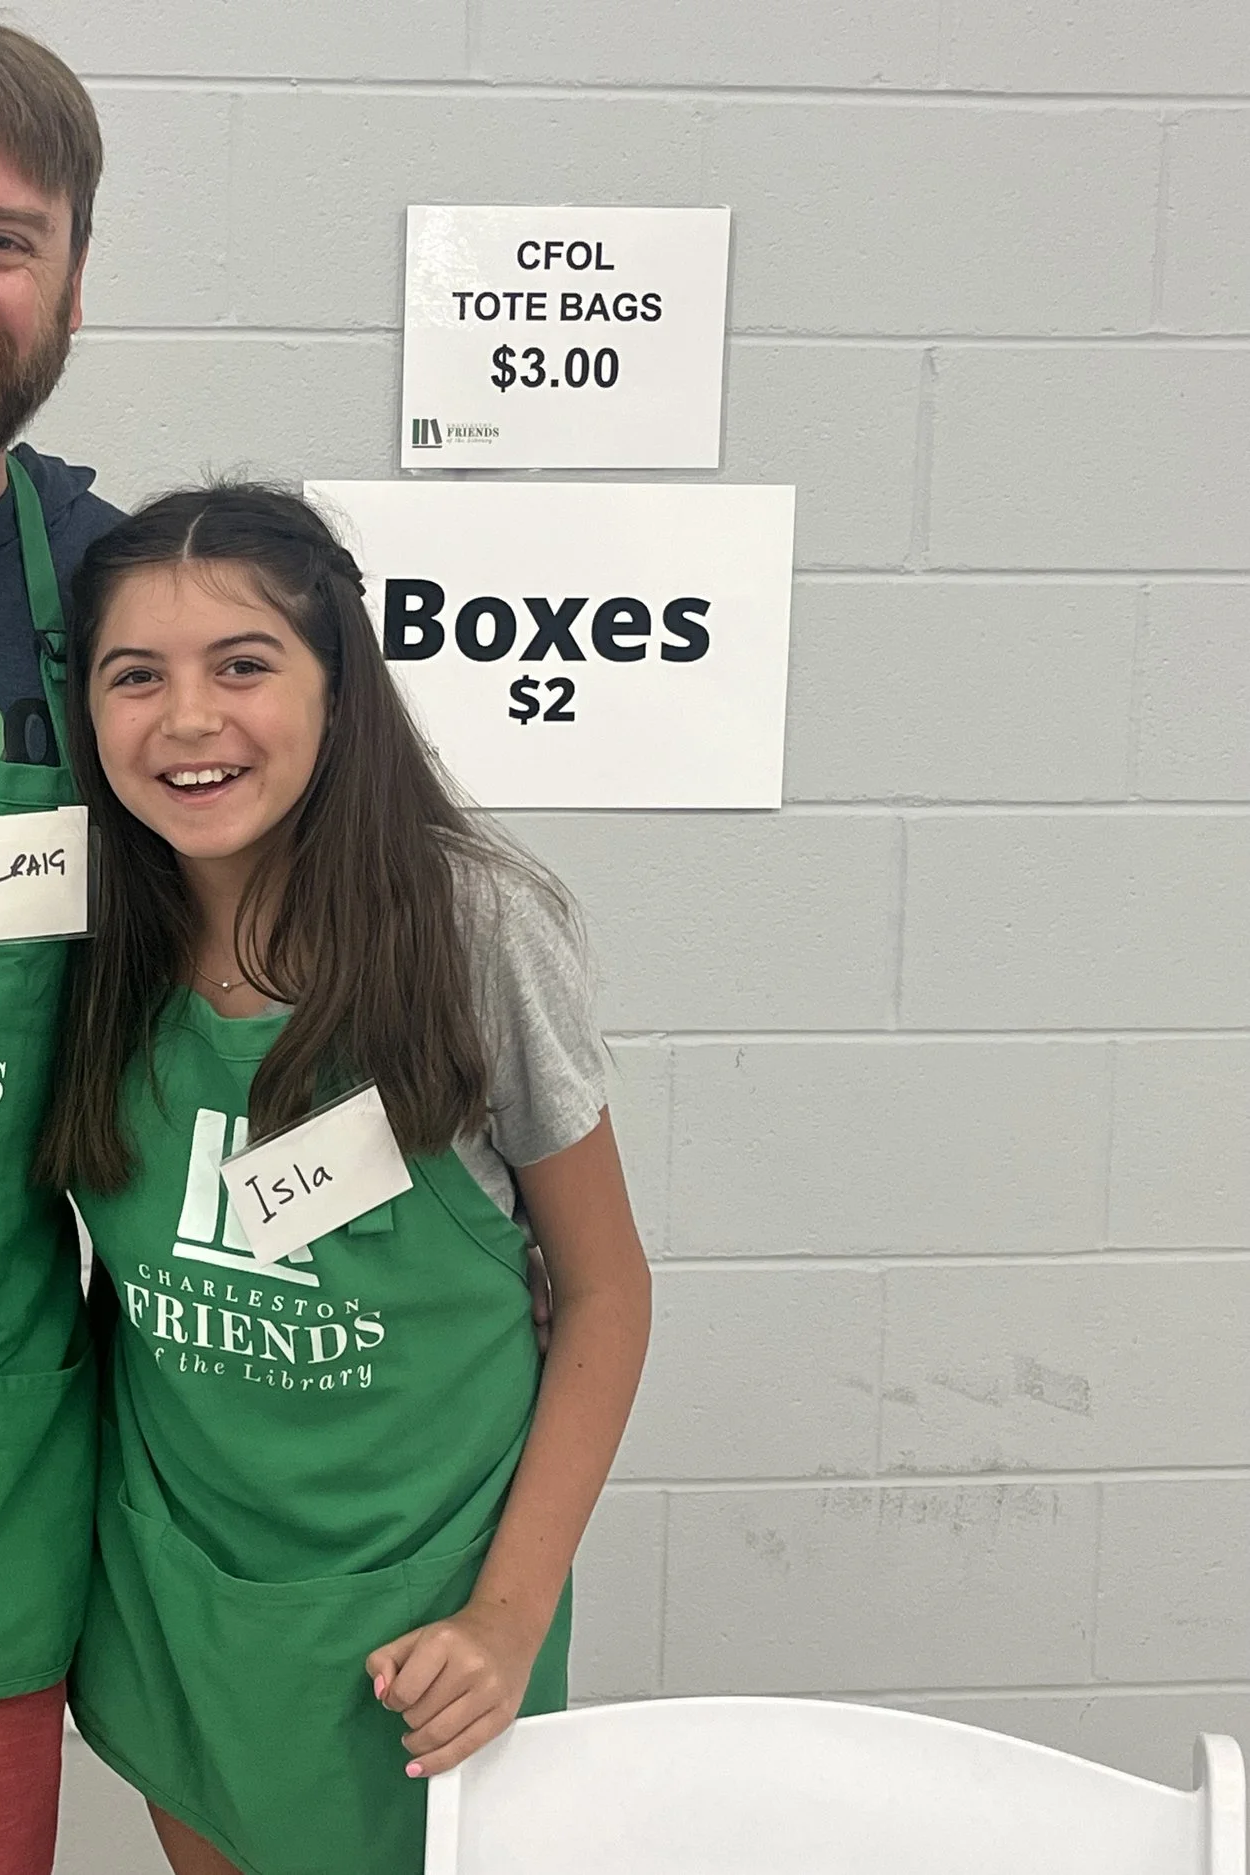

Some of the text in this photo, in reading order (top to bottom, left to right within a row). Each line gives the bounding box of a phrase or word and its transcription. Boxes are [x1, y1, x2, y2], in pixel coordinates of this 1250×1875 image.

[516, 241, 616, 271] CFOL
[452, 291, 663, 322] TOTE BAGS
[490, 344, 620, 393] $3.00
[447, 427, 500, 438] FRIENDS
[383, 577, 712, 663] Boxes
[508, 675, 576, 725] $2
[245, 1163, 333, 1224] Isla
[138, 1263, 360, 1319] CHARLESTON
[123, 1280, 386, 1365] FRIENDS
[179, 1351, 225, 1375] the
[243, 1363, 373, 1392] Library
